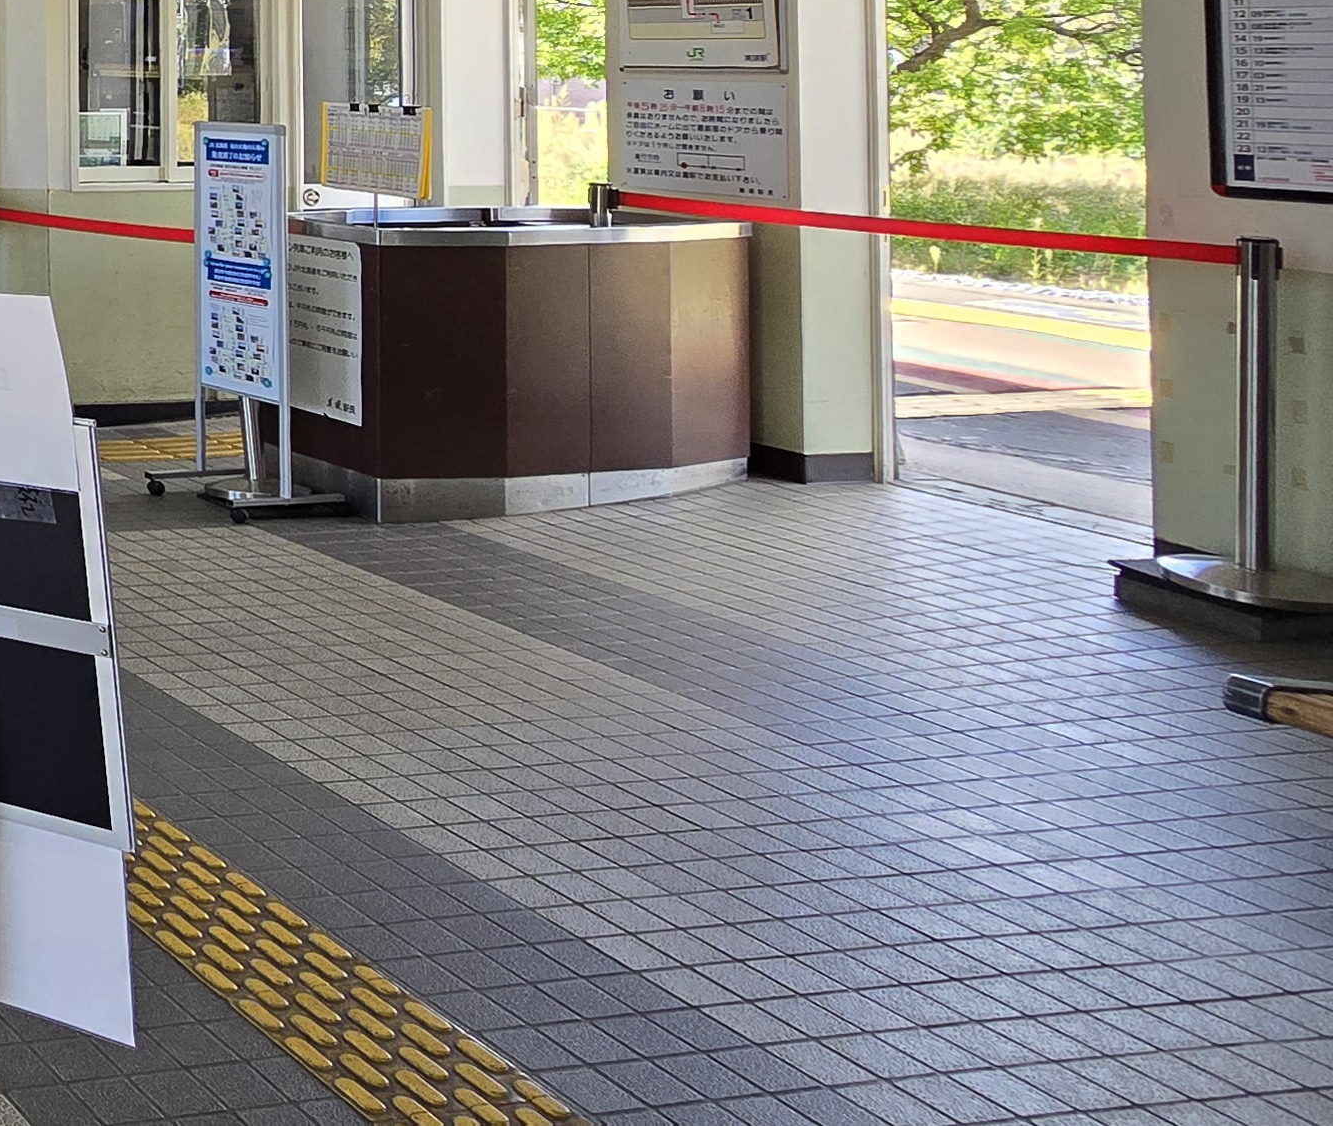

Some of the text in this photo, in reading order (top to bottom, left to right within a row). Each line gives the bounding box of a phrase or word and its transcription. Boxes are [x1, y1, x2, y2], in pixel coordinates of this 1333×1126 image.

[747, 6, 754, 21] 1
[1233, 10, 1247, 19] 12
[1234, 22, 1247, 31] 13
[1234, 34, 1247, 42] 14
[685, 47, 705, 59] JR
[1235, 46, 1248, 55] 15
[1235, 58, 1249, 67] 16
[1235, 70, 1249, 79] 17
[1236, 82, 1250, 92] 18
[663, 88, 736, 102] お願い
[1236, 95, 1250, 104] 19
[1235, 107, 1251, 116] 20
[1235, 119, 1250, 128] 21
[1236, 132, 1251, 140] 22
[1237, 144, 1252, 153] 23
